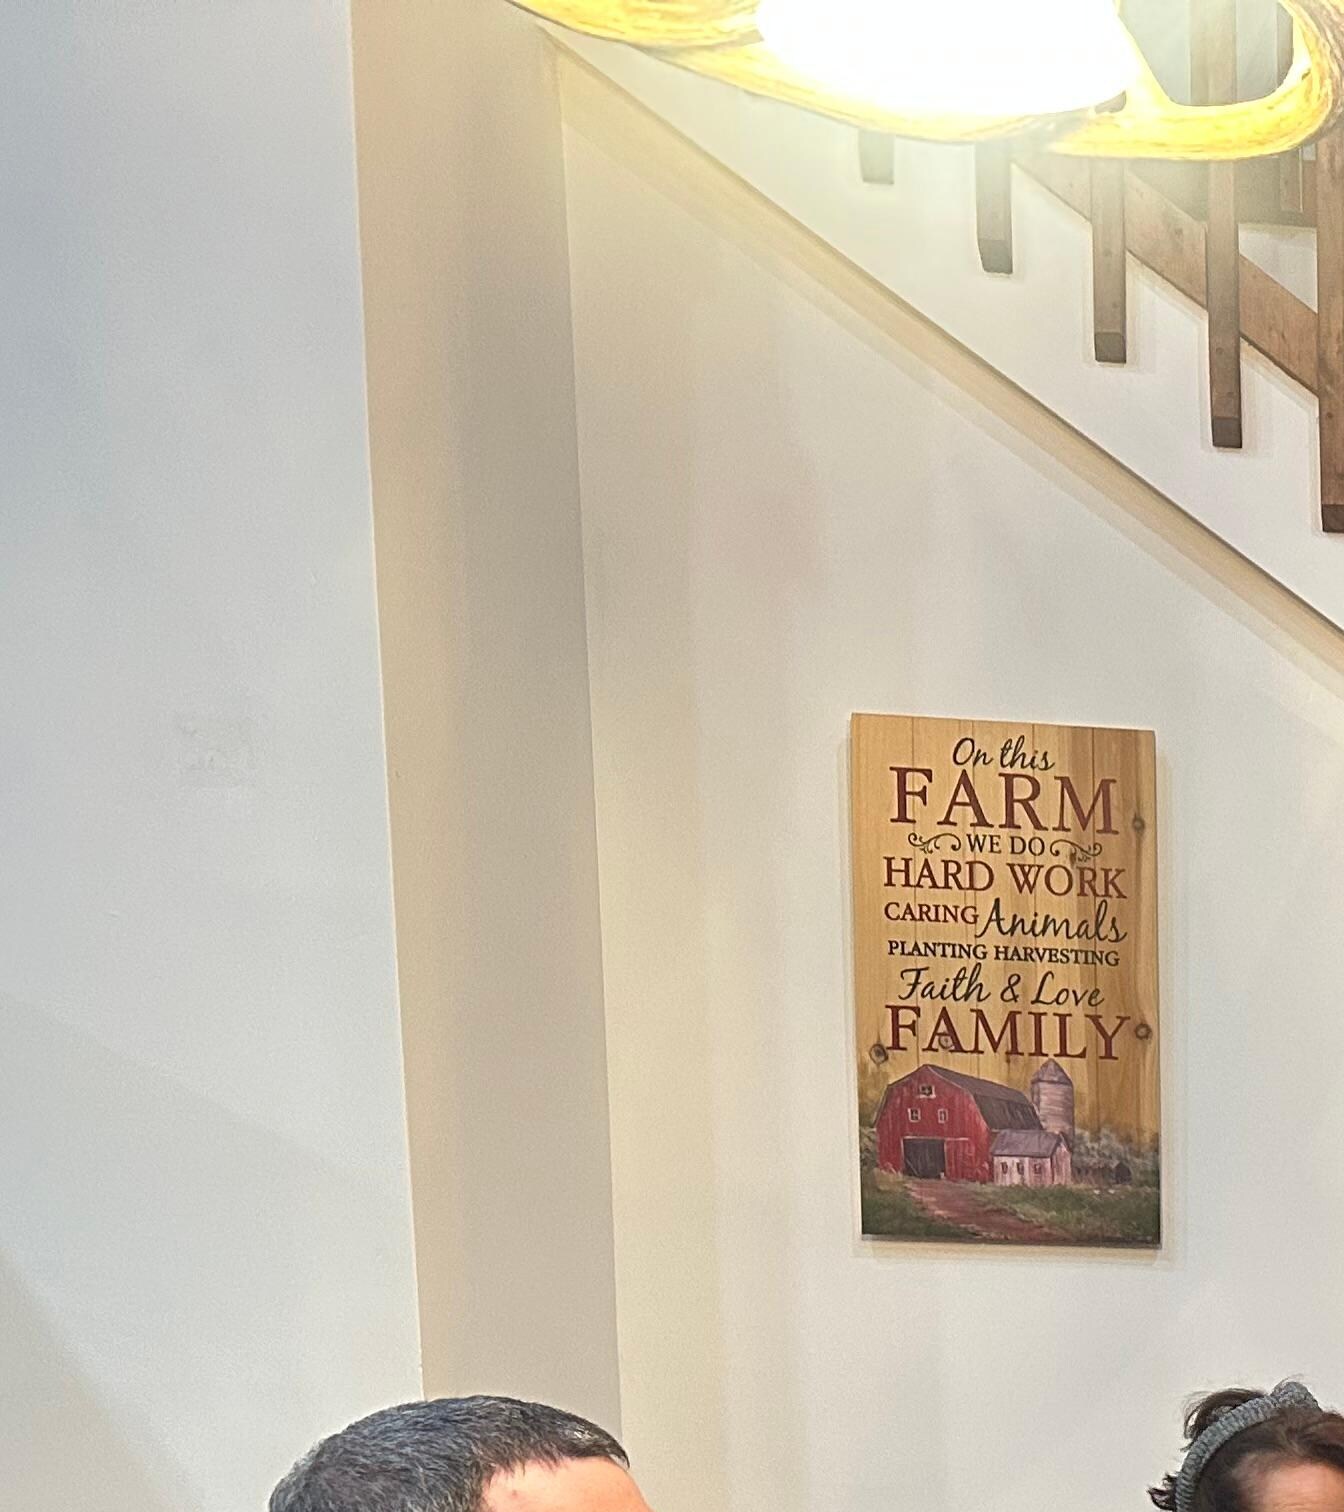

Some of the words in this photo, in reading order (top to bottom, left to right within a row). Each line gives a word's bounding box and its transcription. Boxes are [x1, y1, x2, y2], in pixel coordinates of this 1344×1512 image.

[952, 737, 993, 766] On
[1000, 735, 1055, 771] this
[889, 766, 1119, 835] FARM
[966, 833, 1001, 854] WE
[1009, 836, 1045, 857] DO
[883, 856, 994, 892] HARD
[1006, 862, 1127, 899] WORK
[884, 902, 979, 925] CARING
[975, 897, 1127, 943] Animals
[888, 940, 987, 960] PLANTING
[994, 945, 1120, 967] HARVESTING
[898, 962, 991, 1003] Faith
[1000, 973, 1021, 1004] &
[1031, 970, 1104, 1007] Love
[885, 1004, 1131, 1060] FAMILY
